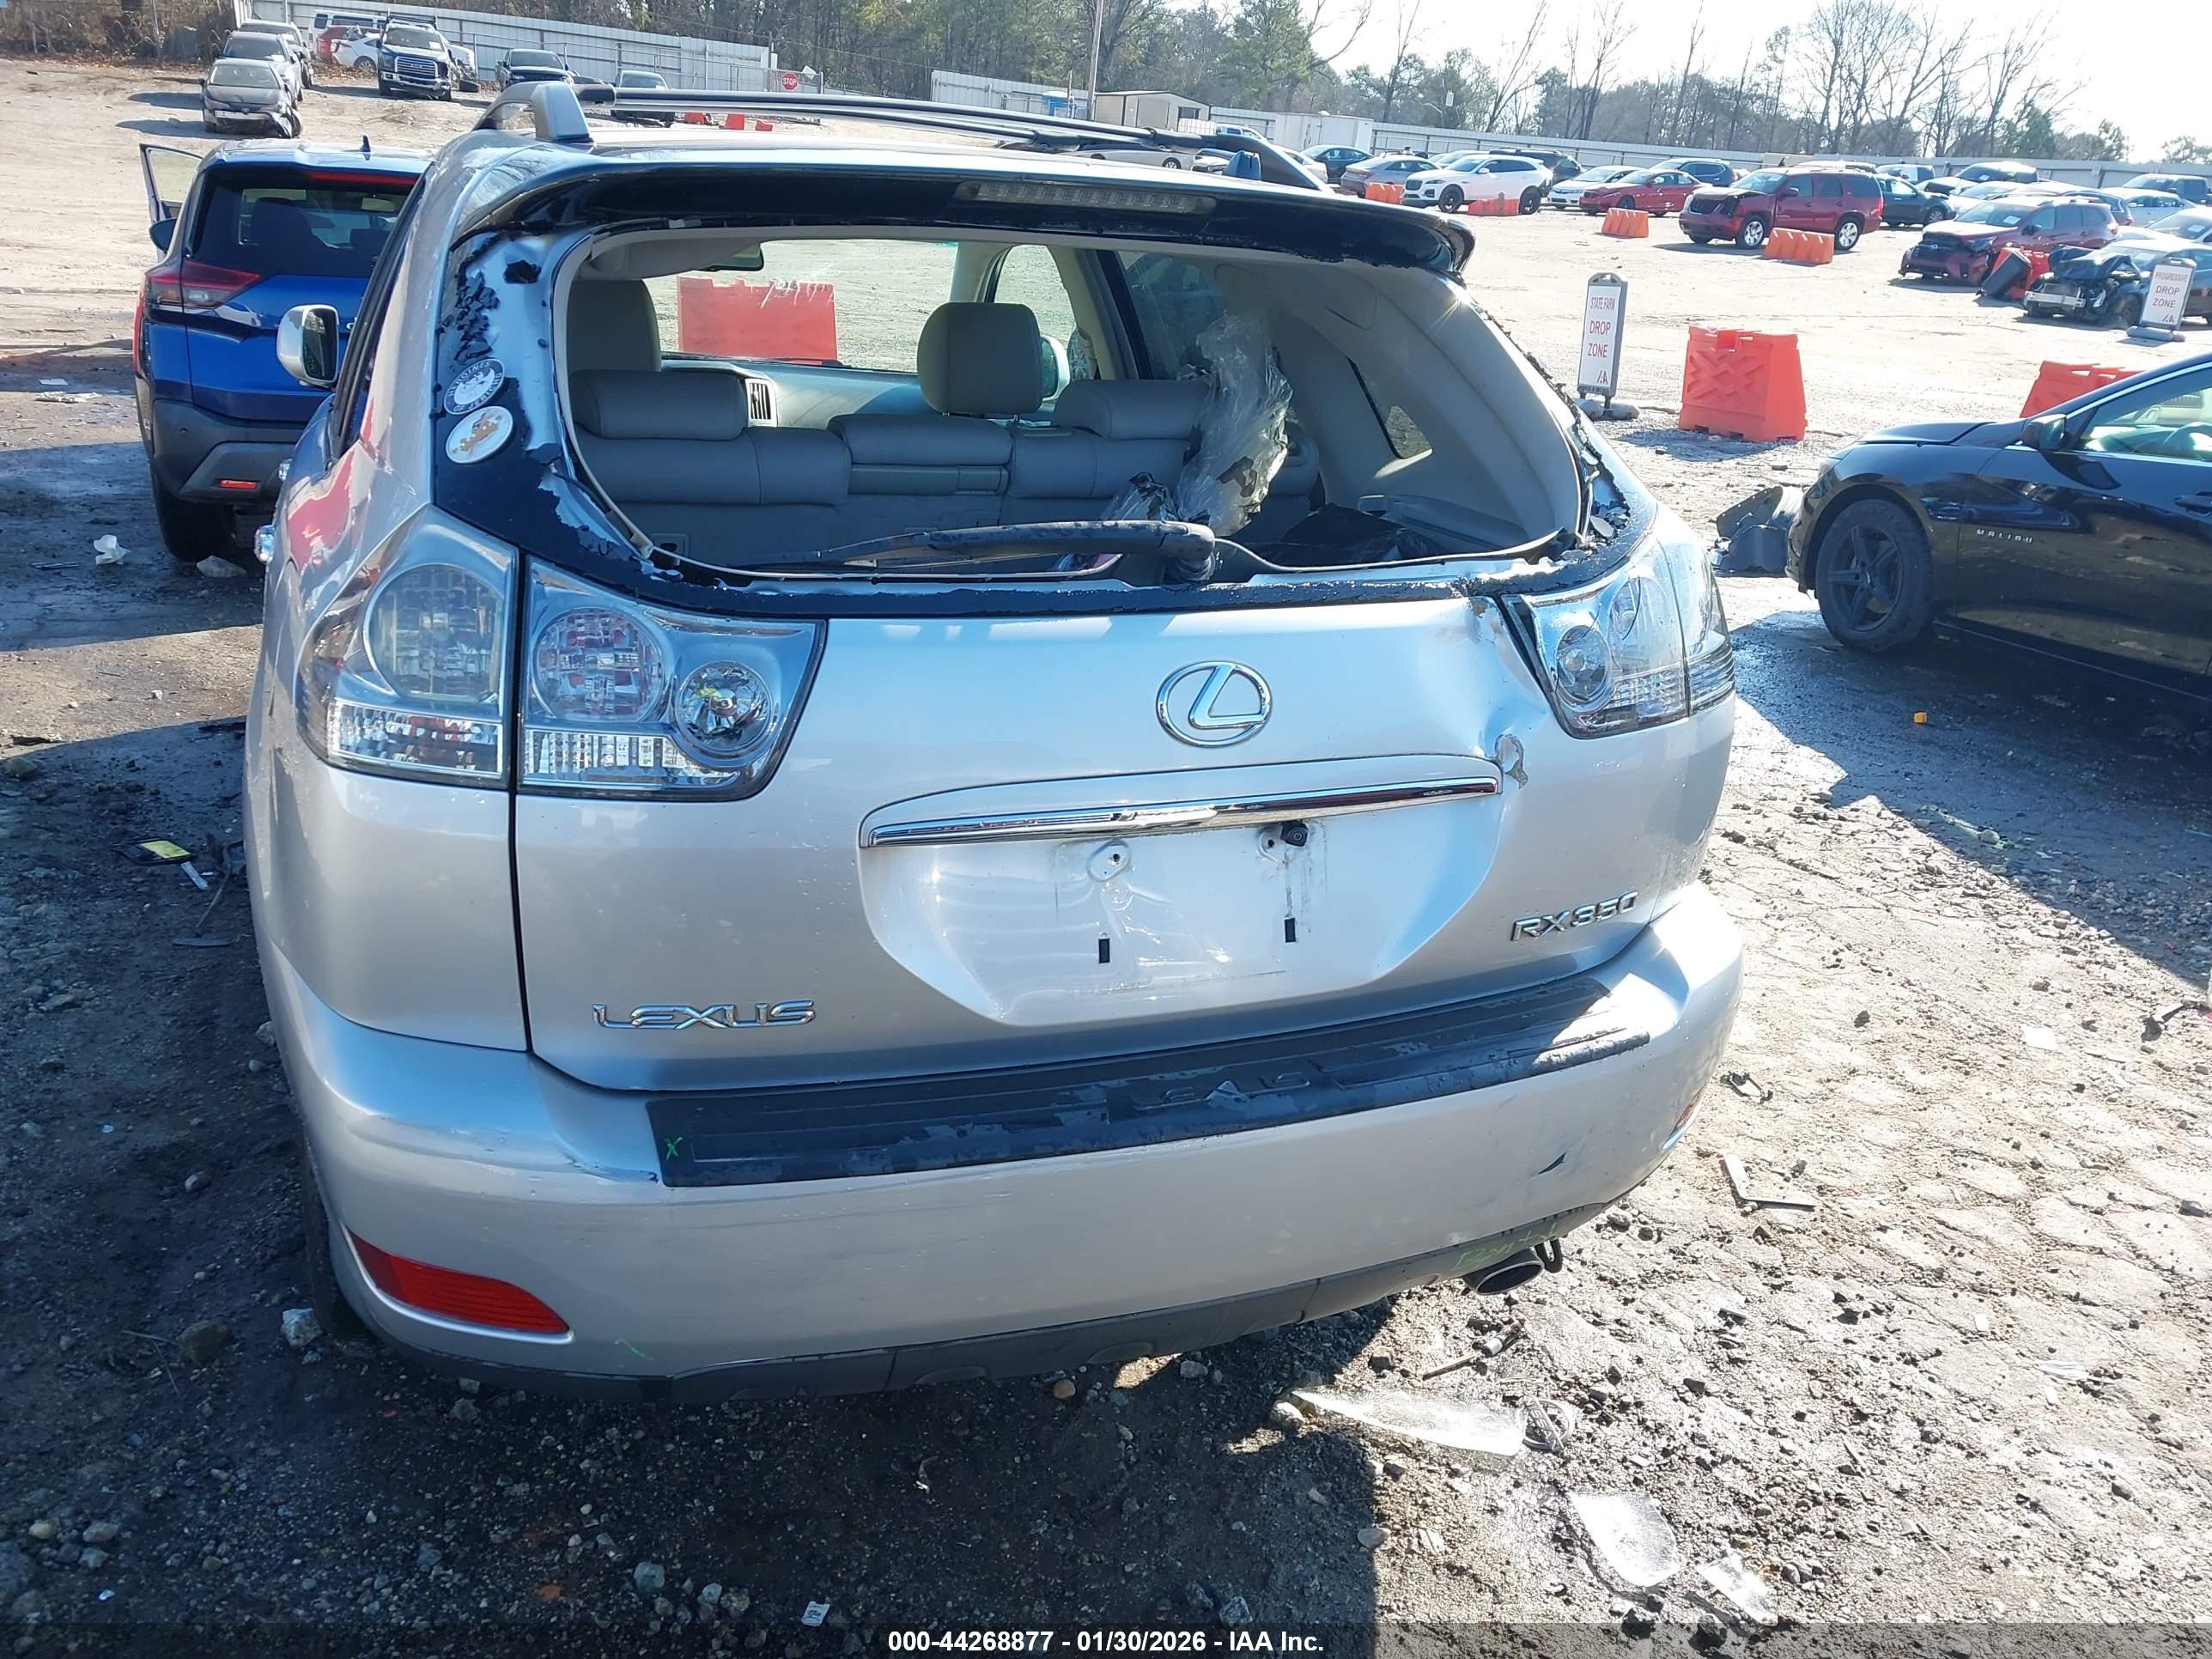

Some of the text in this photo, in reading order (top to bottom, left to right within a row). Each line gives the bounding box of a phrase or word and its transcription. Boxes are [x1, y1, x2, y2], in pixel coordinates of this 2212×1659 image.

[2156, 285, 2179, 295] DROP
[1590, 296, 1615, 310] STATE FARM
[2153, 297, 2177, 308] ZONE
[1589, 321, 1611, 335] DROP
[1588, 343, 1608, 357] ZONE
[447, 361, 490, 398] HEROINES
[468, 372, 502, 410] JERICHO
[1976, 528, 2033, 544] MALIBU
[592, 998, 816, 1030] LEXUS
